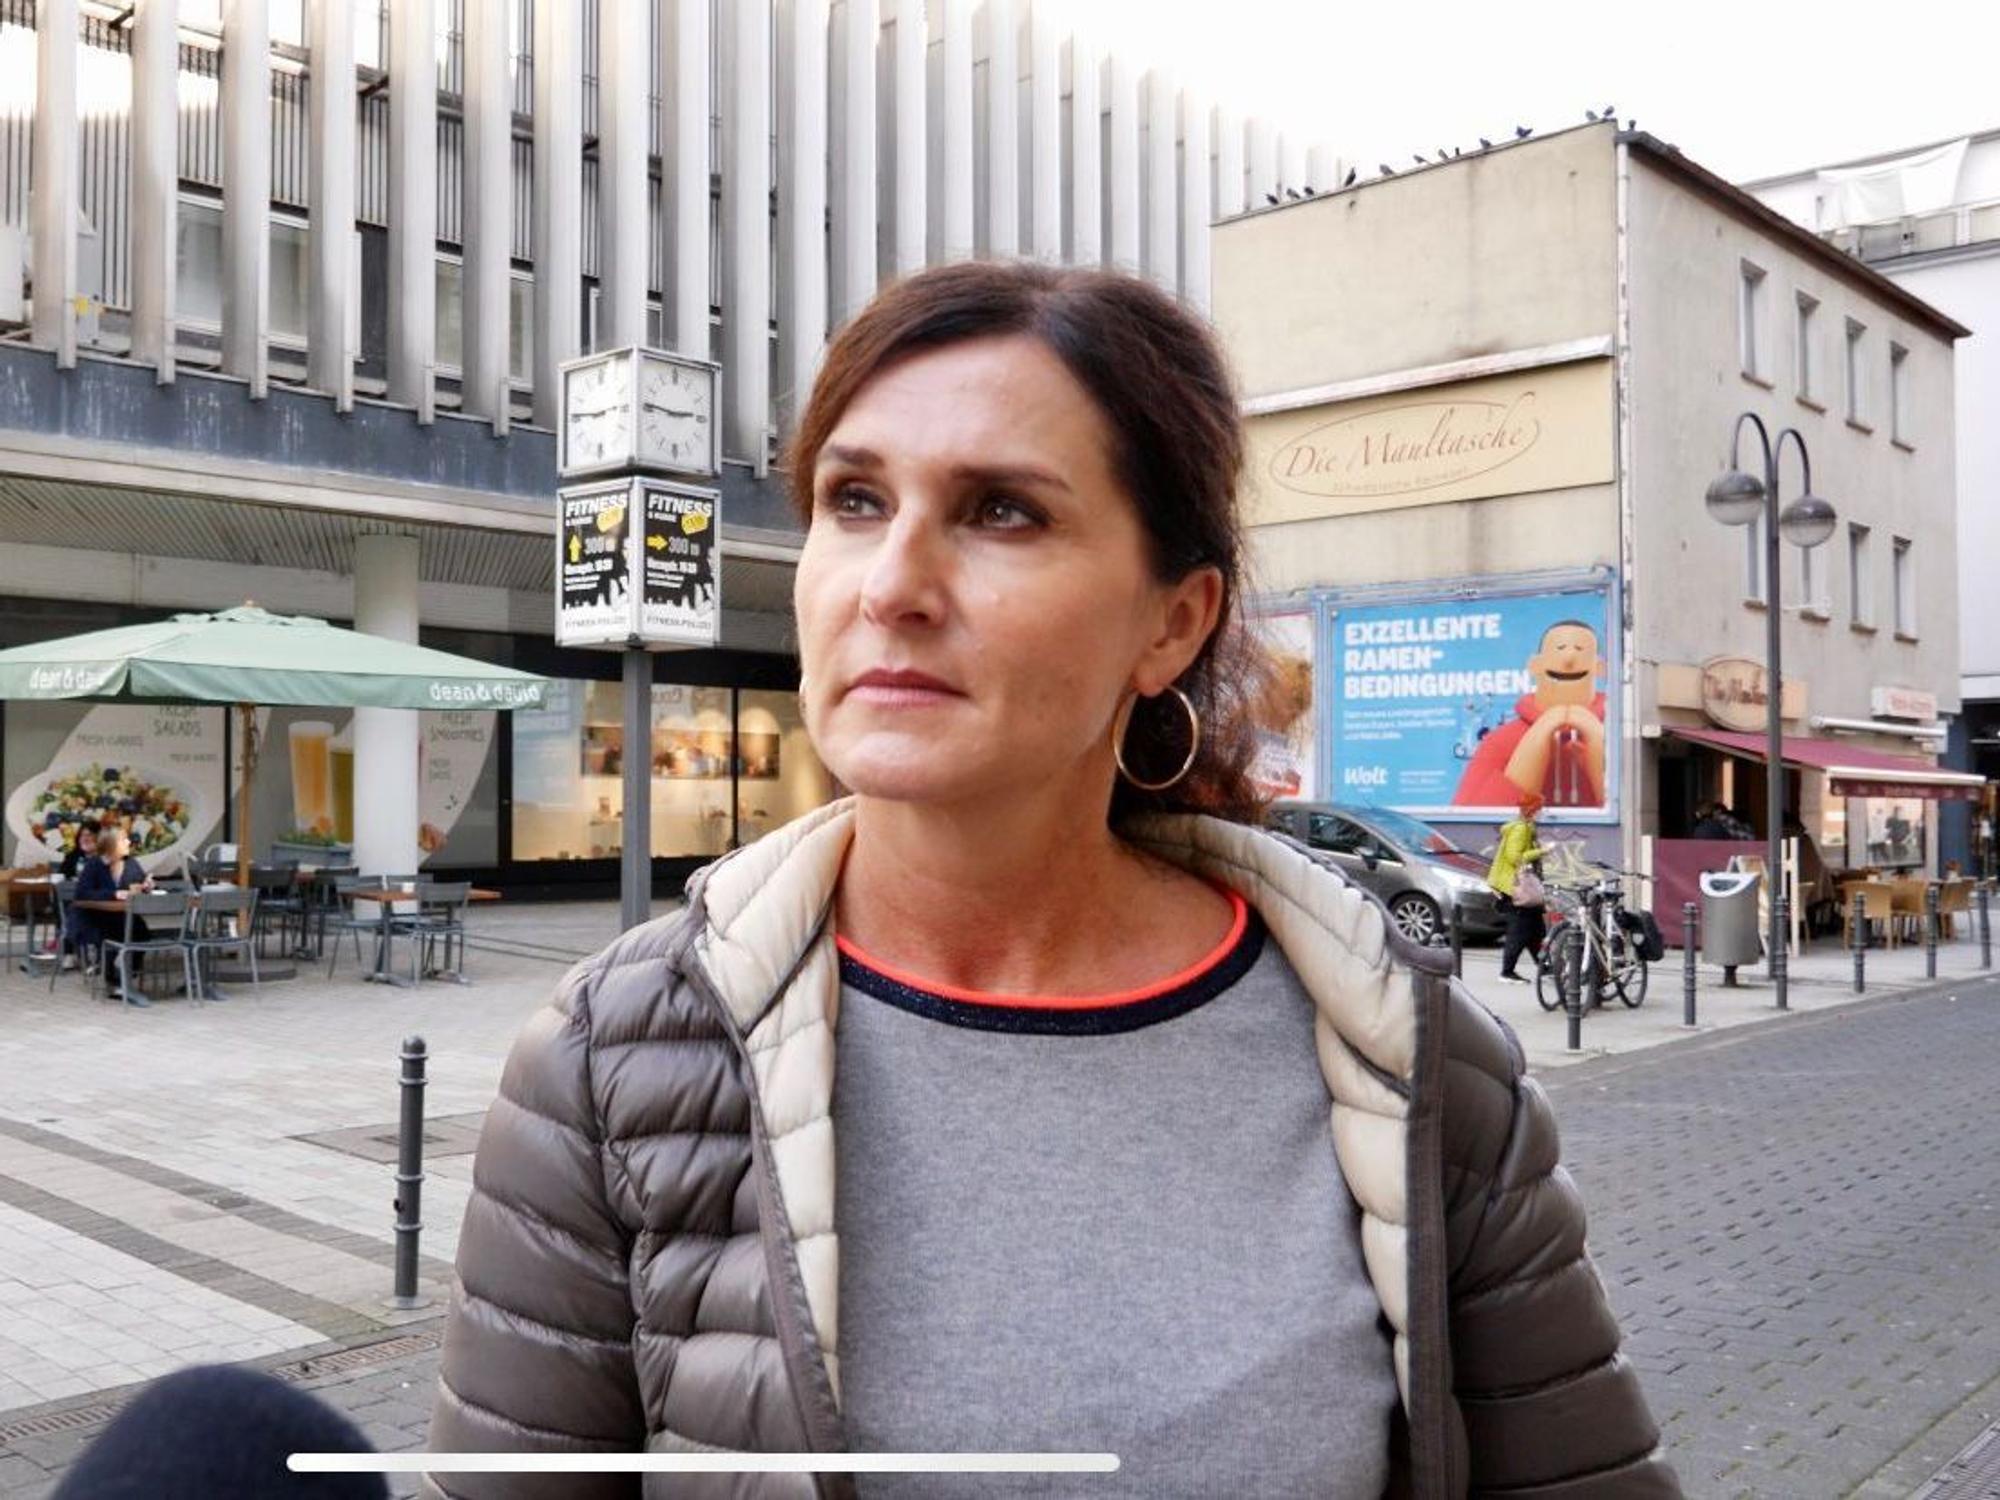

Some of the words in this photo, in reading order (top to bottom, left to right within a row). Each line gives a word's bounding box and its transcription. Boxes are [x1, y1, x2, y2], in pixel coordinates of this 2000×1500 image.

[1286, 446, 1338, 477] Die
[1345, 391, 1535, 474] Maultasche
[566, 494, 627, 517] FITNESS
[648, 494, 713, 518] FITNESS
[1344, 613, 1502, 646] EXZELLENTE
[1344, 645, 1444, 672] RAMEN-
[1344, 669, 1537, 700] BEDINGUNGEN.
[1344, 765, 1388, 786] Wolt
